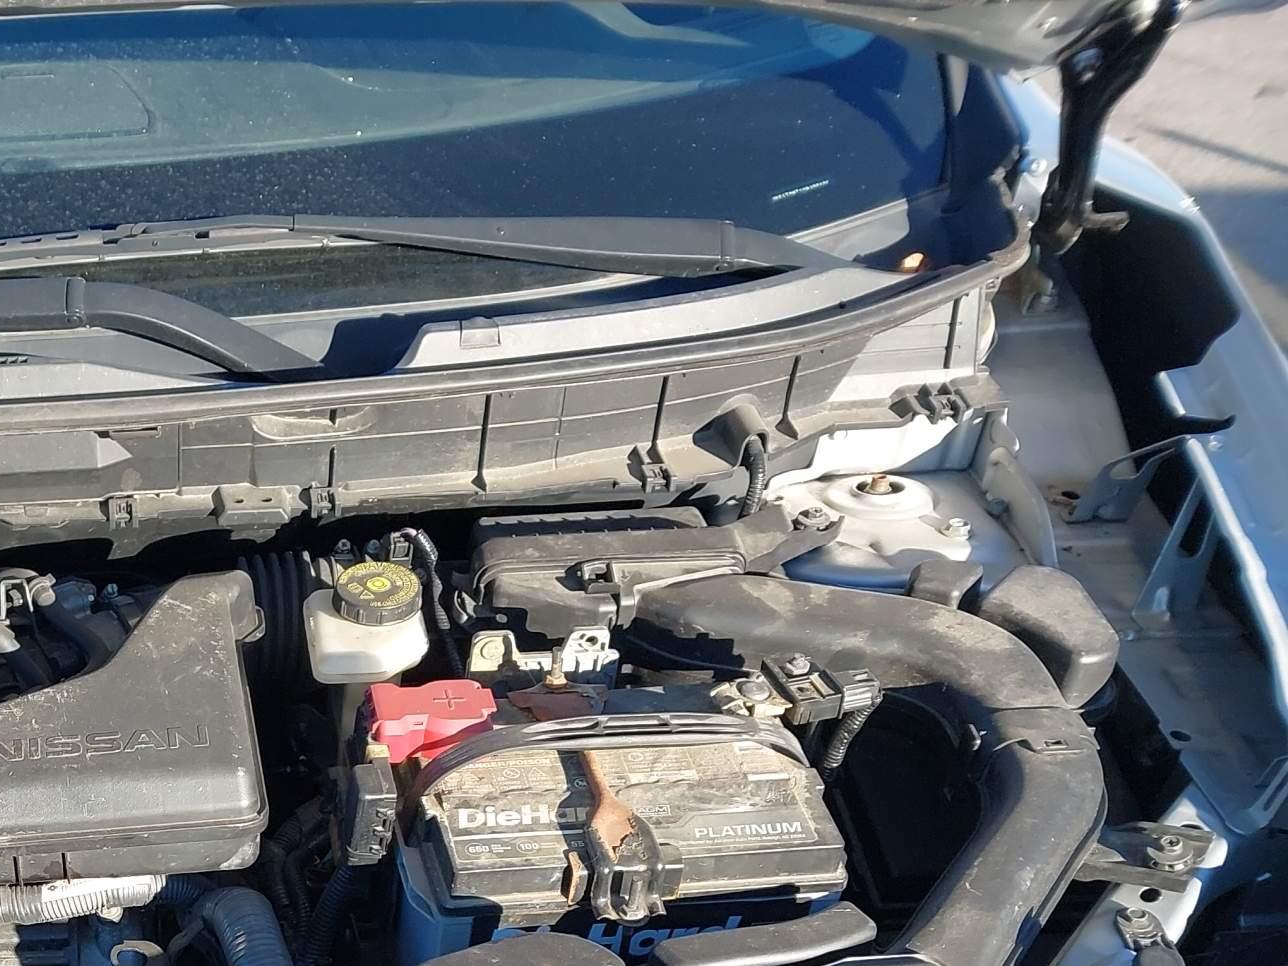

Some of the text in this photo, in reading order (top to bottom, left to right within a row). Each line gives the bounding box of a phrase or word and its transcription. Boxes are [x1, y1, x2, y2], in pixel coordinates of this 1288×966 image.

[464, 758, 552, 769] ANGER/POISON
[457, 803, 590, 830] DieHar
[694, 821, 802, 838] PLATINUM
[468, 844, 489, 853] 650
[520, 842, 538, 851] 100
